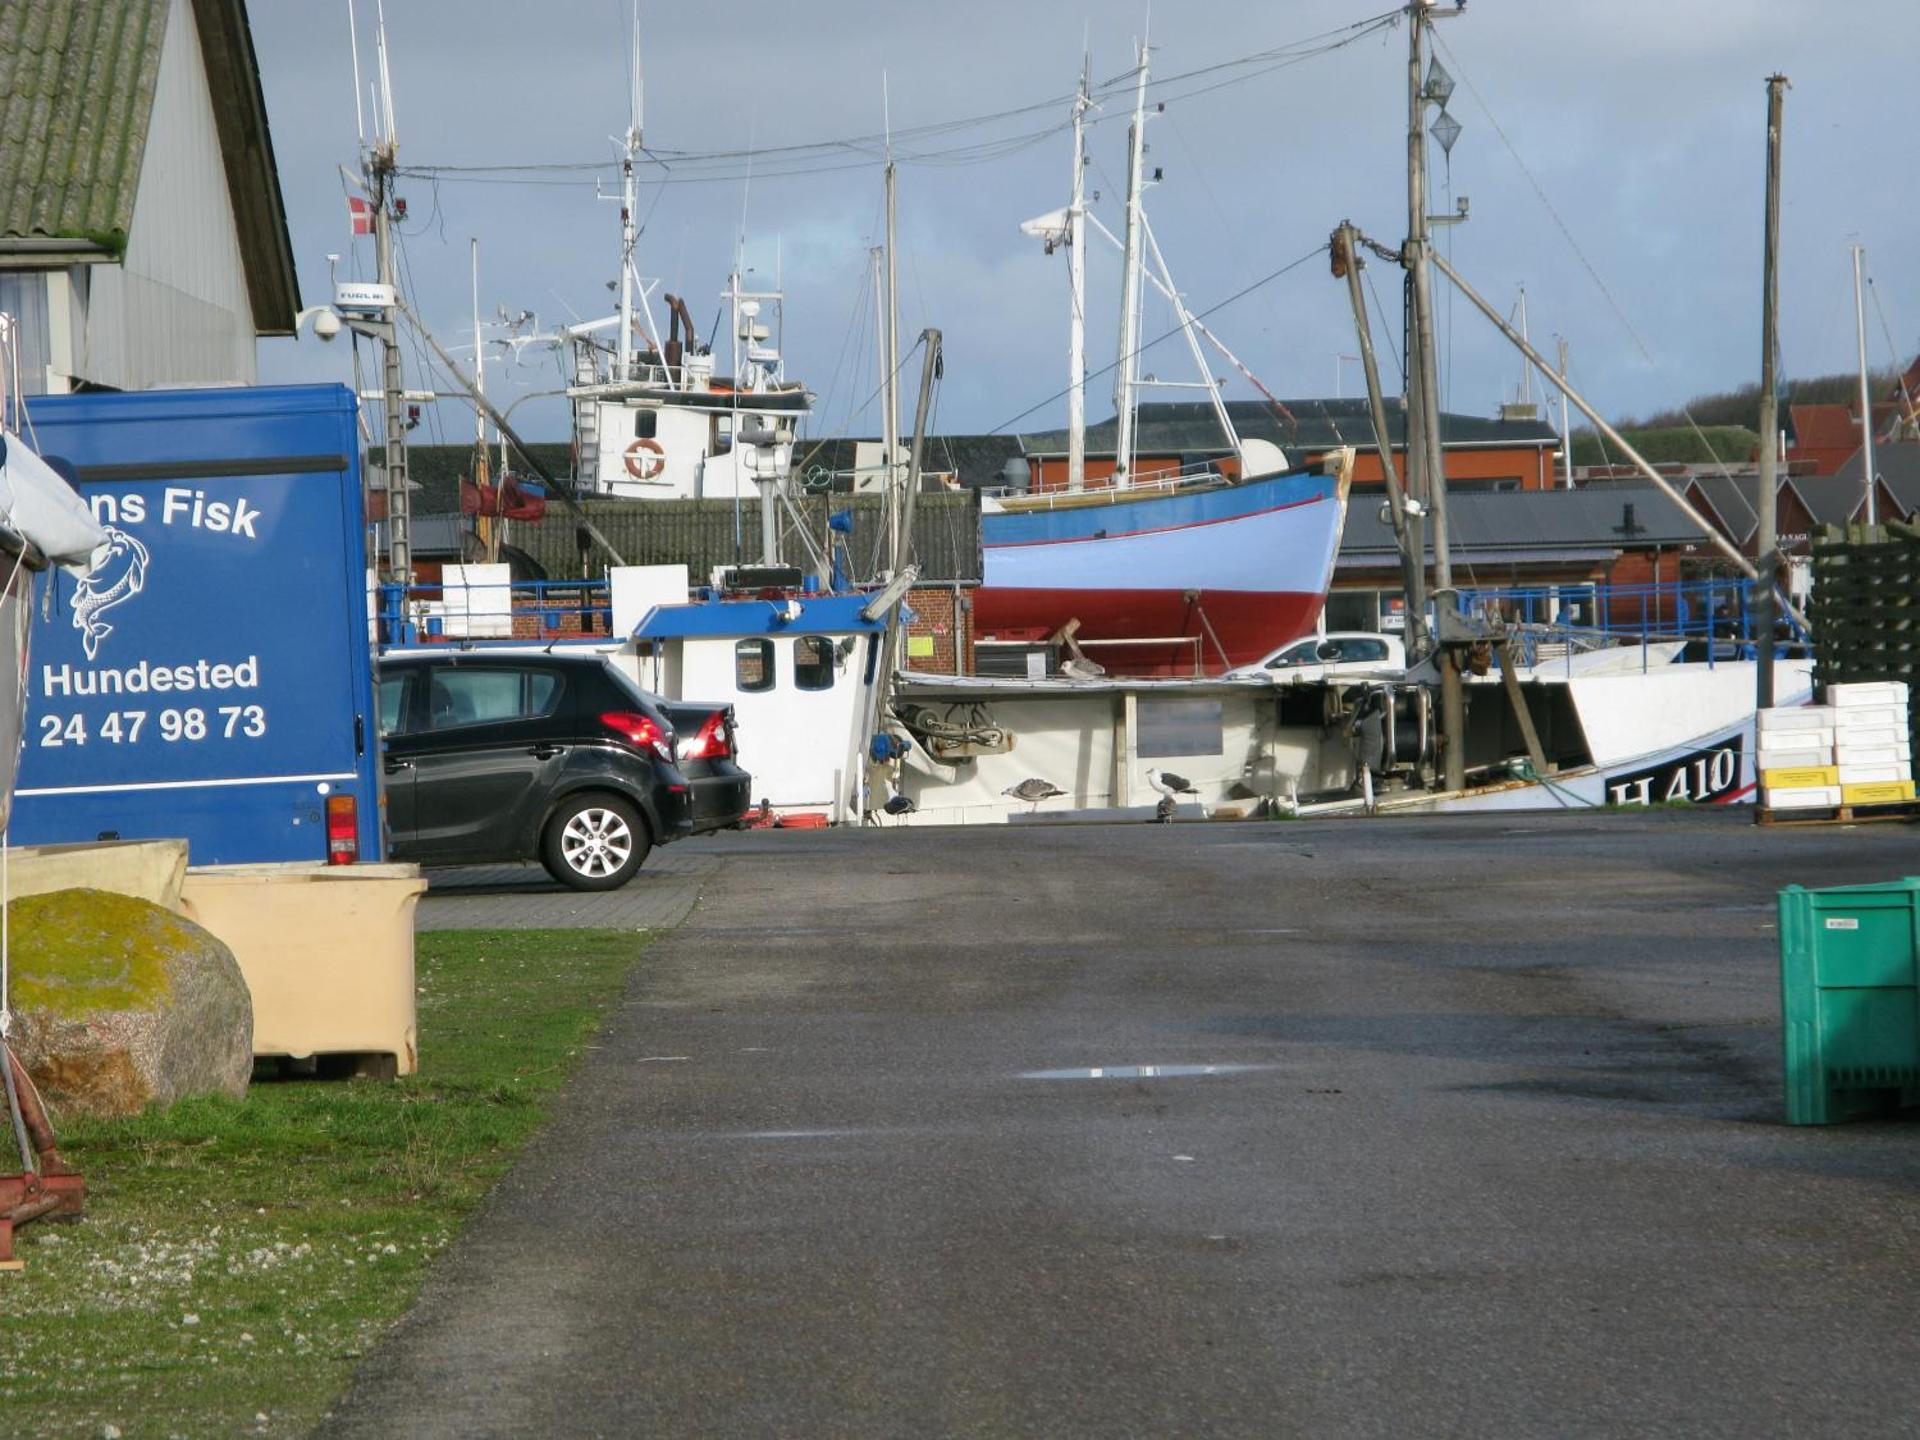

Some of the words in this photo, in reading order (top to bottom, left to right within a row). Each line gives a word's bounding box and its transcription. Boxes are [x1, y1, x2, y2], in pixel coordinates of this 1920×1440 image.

[91, 493, 146, 524] ns
[162, 487, 261, 539] Fisk
[43, 655, 258, 697] Hundested
[40, 713, 87, 748] 24
[100, 711, 146, 743] 47
[159, 708, 206, 742] 98
[218, 705, 266, 738] 73
[1666, 748, 1735, 802] 410
